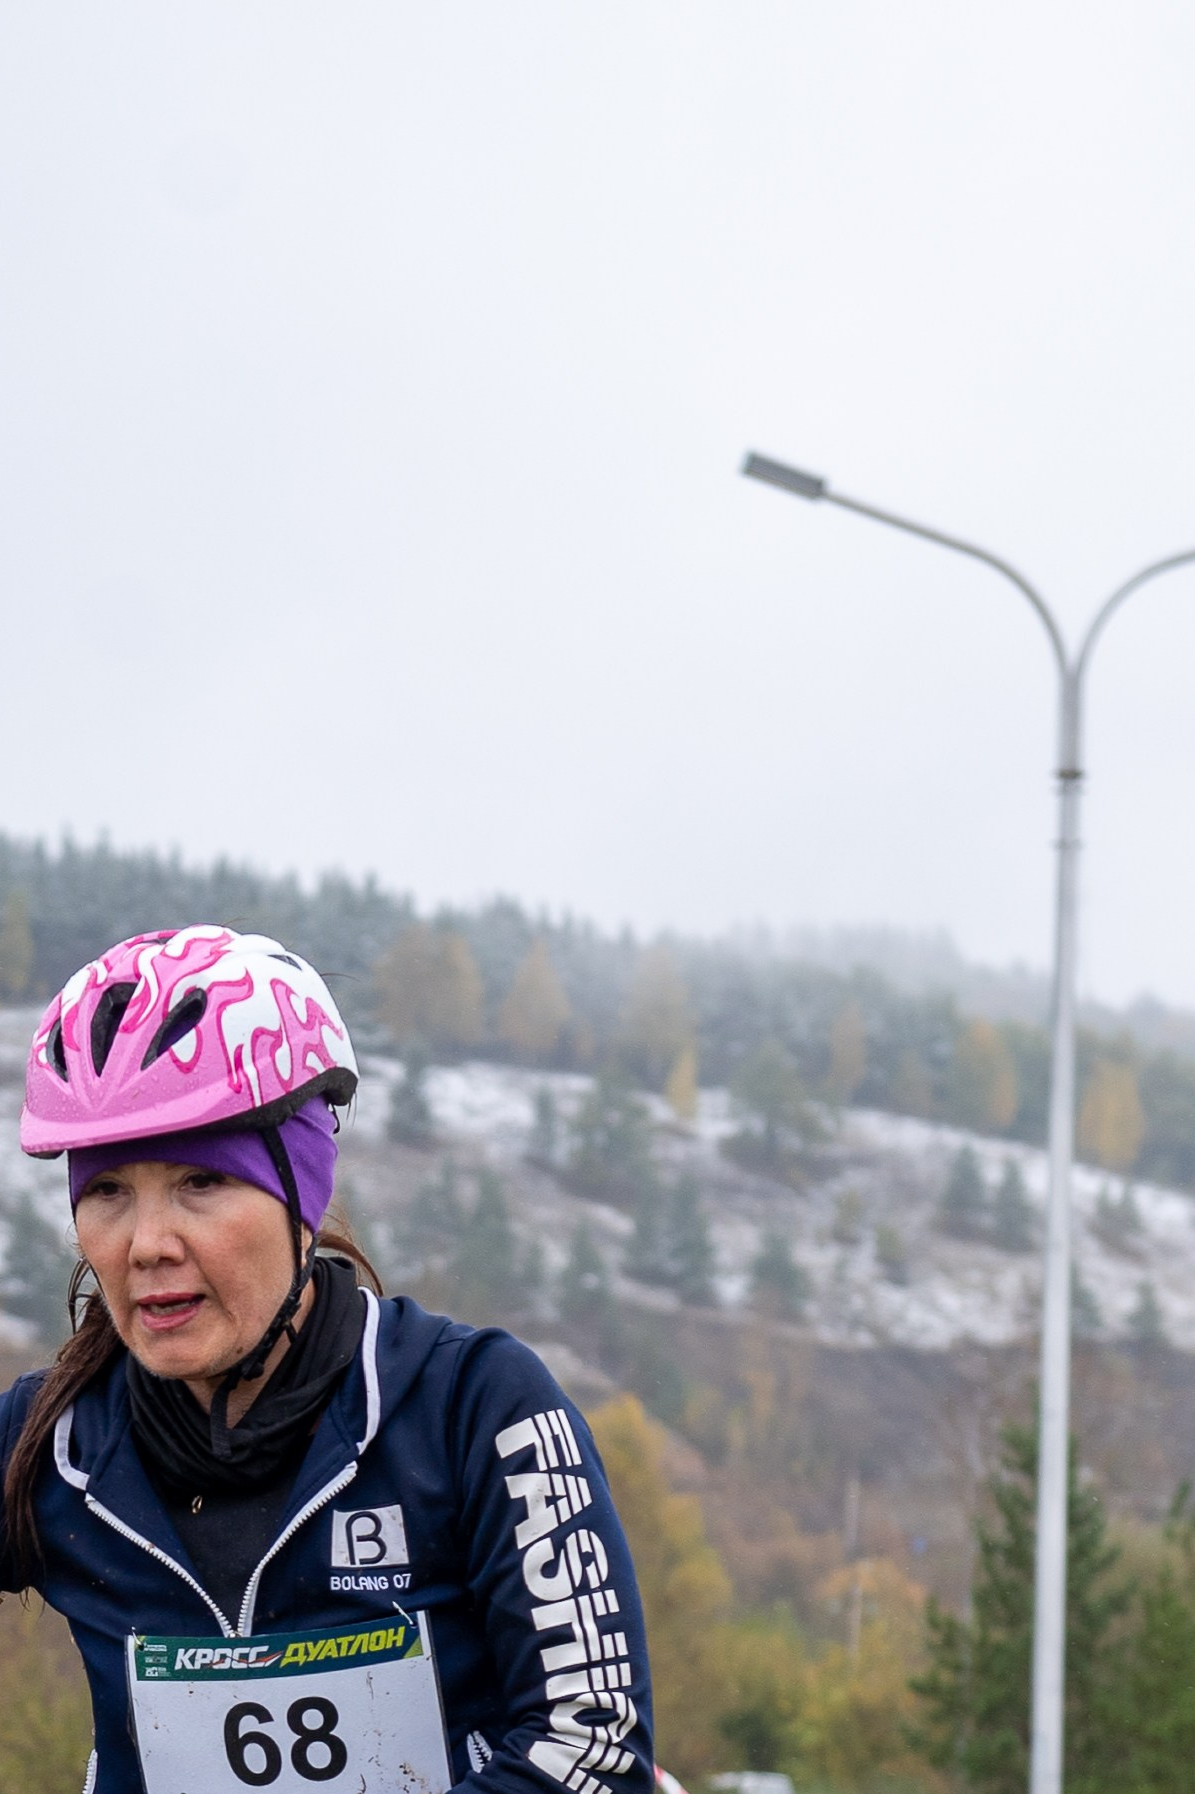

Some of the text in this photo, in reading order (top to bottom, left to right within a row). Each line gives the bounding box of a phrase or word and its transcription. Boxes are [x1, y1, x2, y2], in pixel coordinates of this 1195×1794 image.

[330, 1575, 389, 1590] BOLANG
[174, 1626, 405, 1670] КРОСС ДУАТЛОН
[224, 1696, 347, 1786] 68
